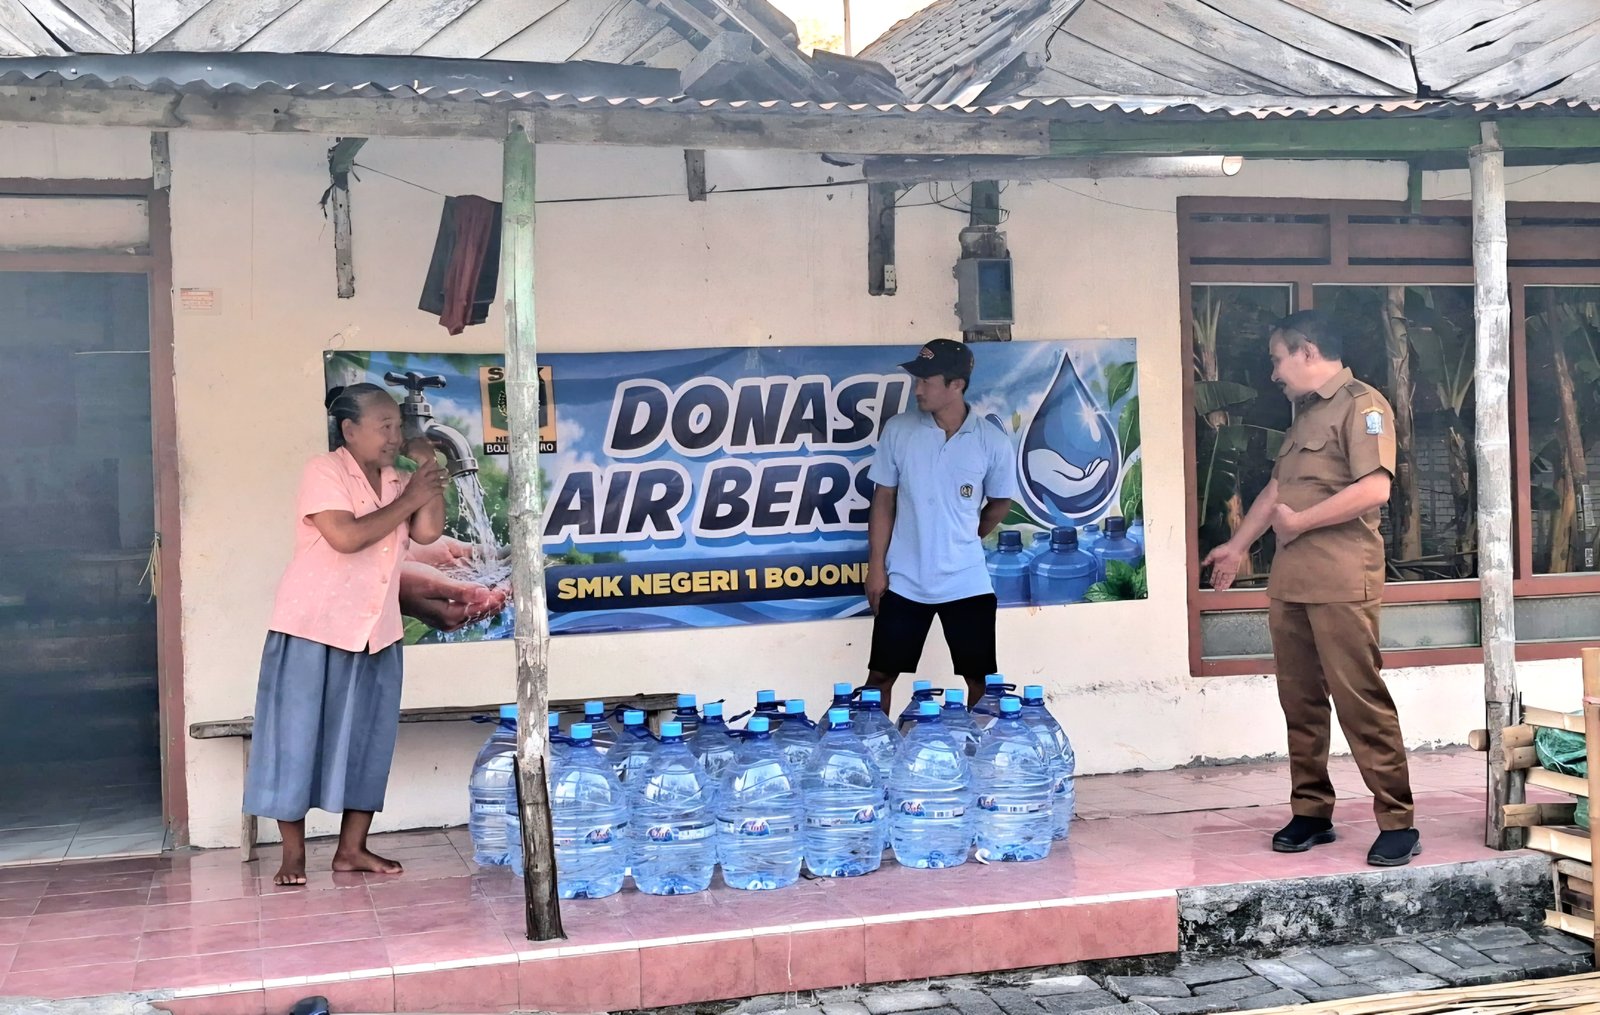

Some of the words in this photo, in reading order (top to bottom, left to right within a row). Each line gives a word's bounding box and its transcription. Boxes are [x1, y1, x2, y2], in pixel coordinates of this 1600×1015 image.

[607, 377, 909, 454] DONASI
[542, 465, 687, 538] AIR
[557, 576, 623, 600] SMK
[630, 569, 739, 596] NEGERI
[744, 568, 758, 590] 1
